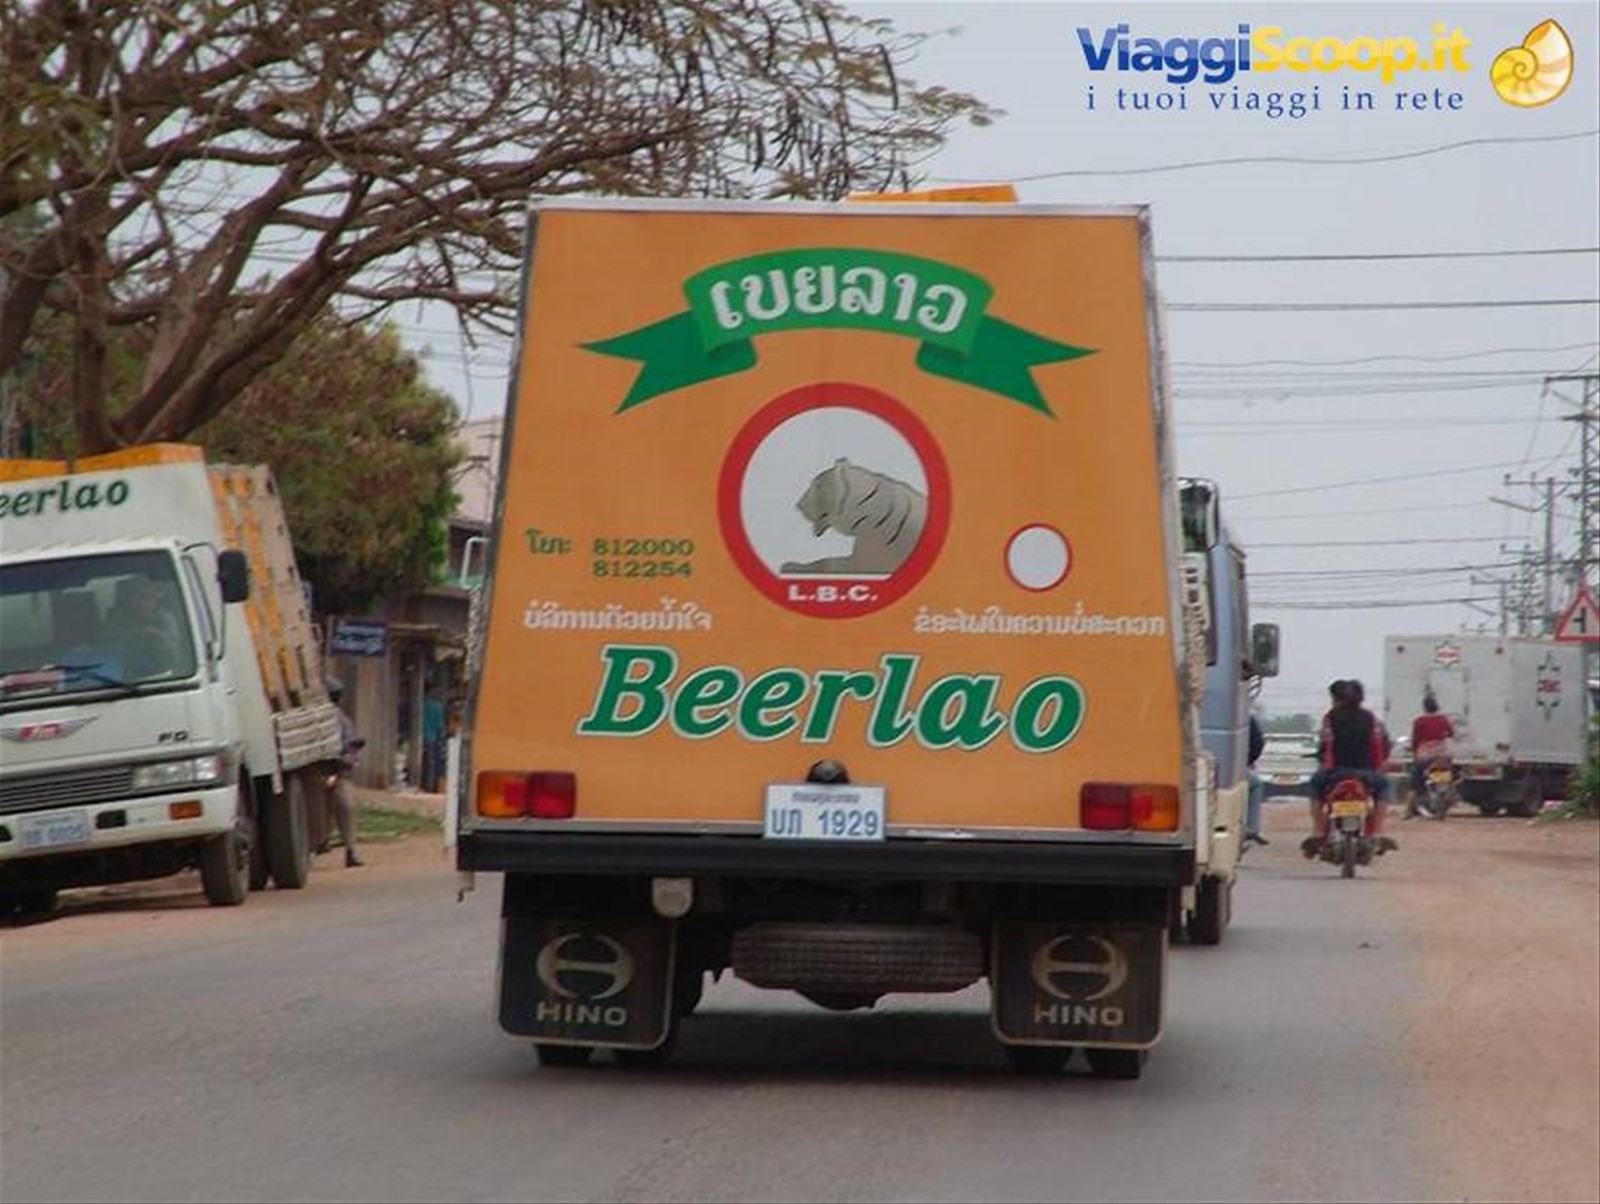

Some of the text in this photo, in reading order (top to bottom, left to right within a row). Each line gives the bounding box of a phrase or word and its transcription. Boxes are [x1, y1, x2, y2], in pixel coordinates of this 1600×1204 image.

[710, 265, 968, 333] ເບຍລາວ
[593, 538, 695, 555] 812000
[593, 560, 692, 578] 812254
[788, 585, 878, 602] L.B.C.
[577, 644, 1087, 753] Beerlao
[818, 810, 878, 836] 1929
[536, 1002, 627, 1026] HINO
[1034, 1004, 1124, 1027] HINO
